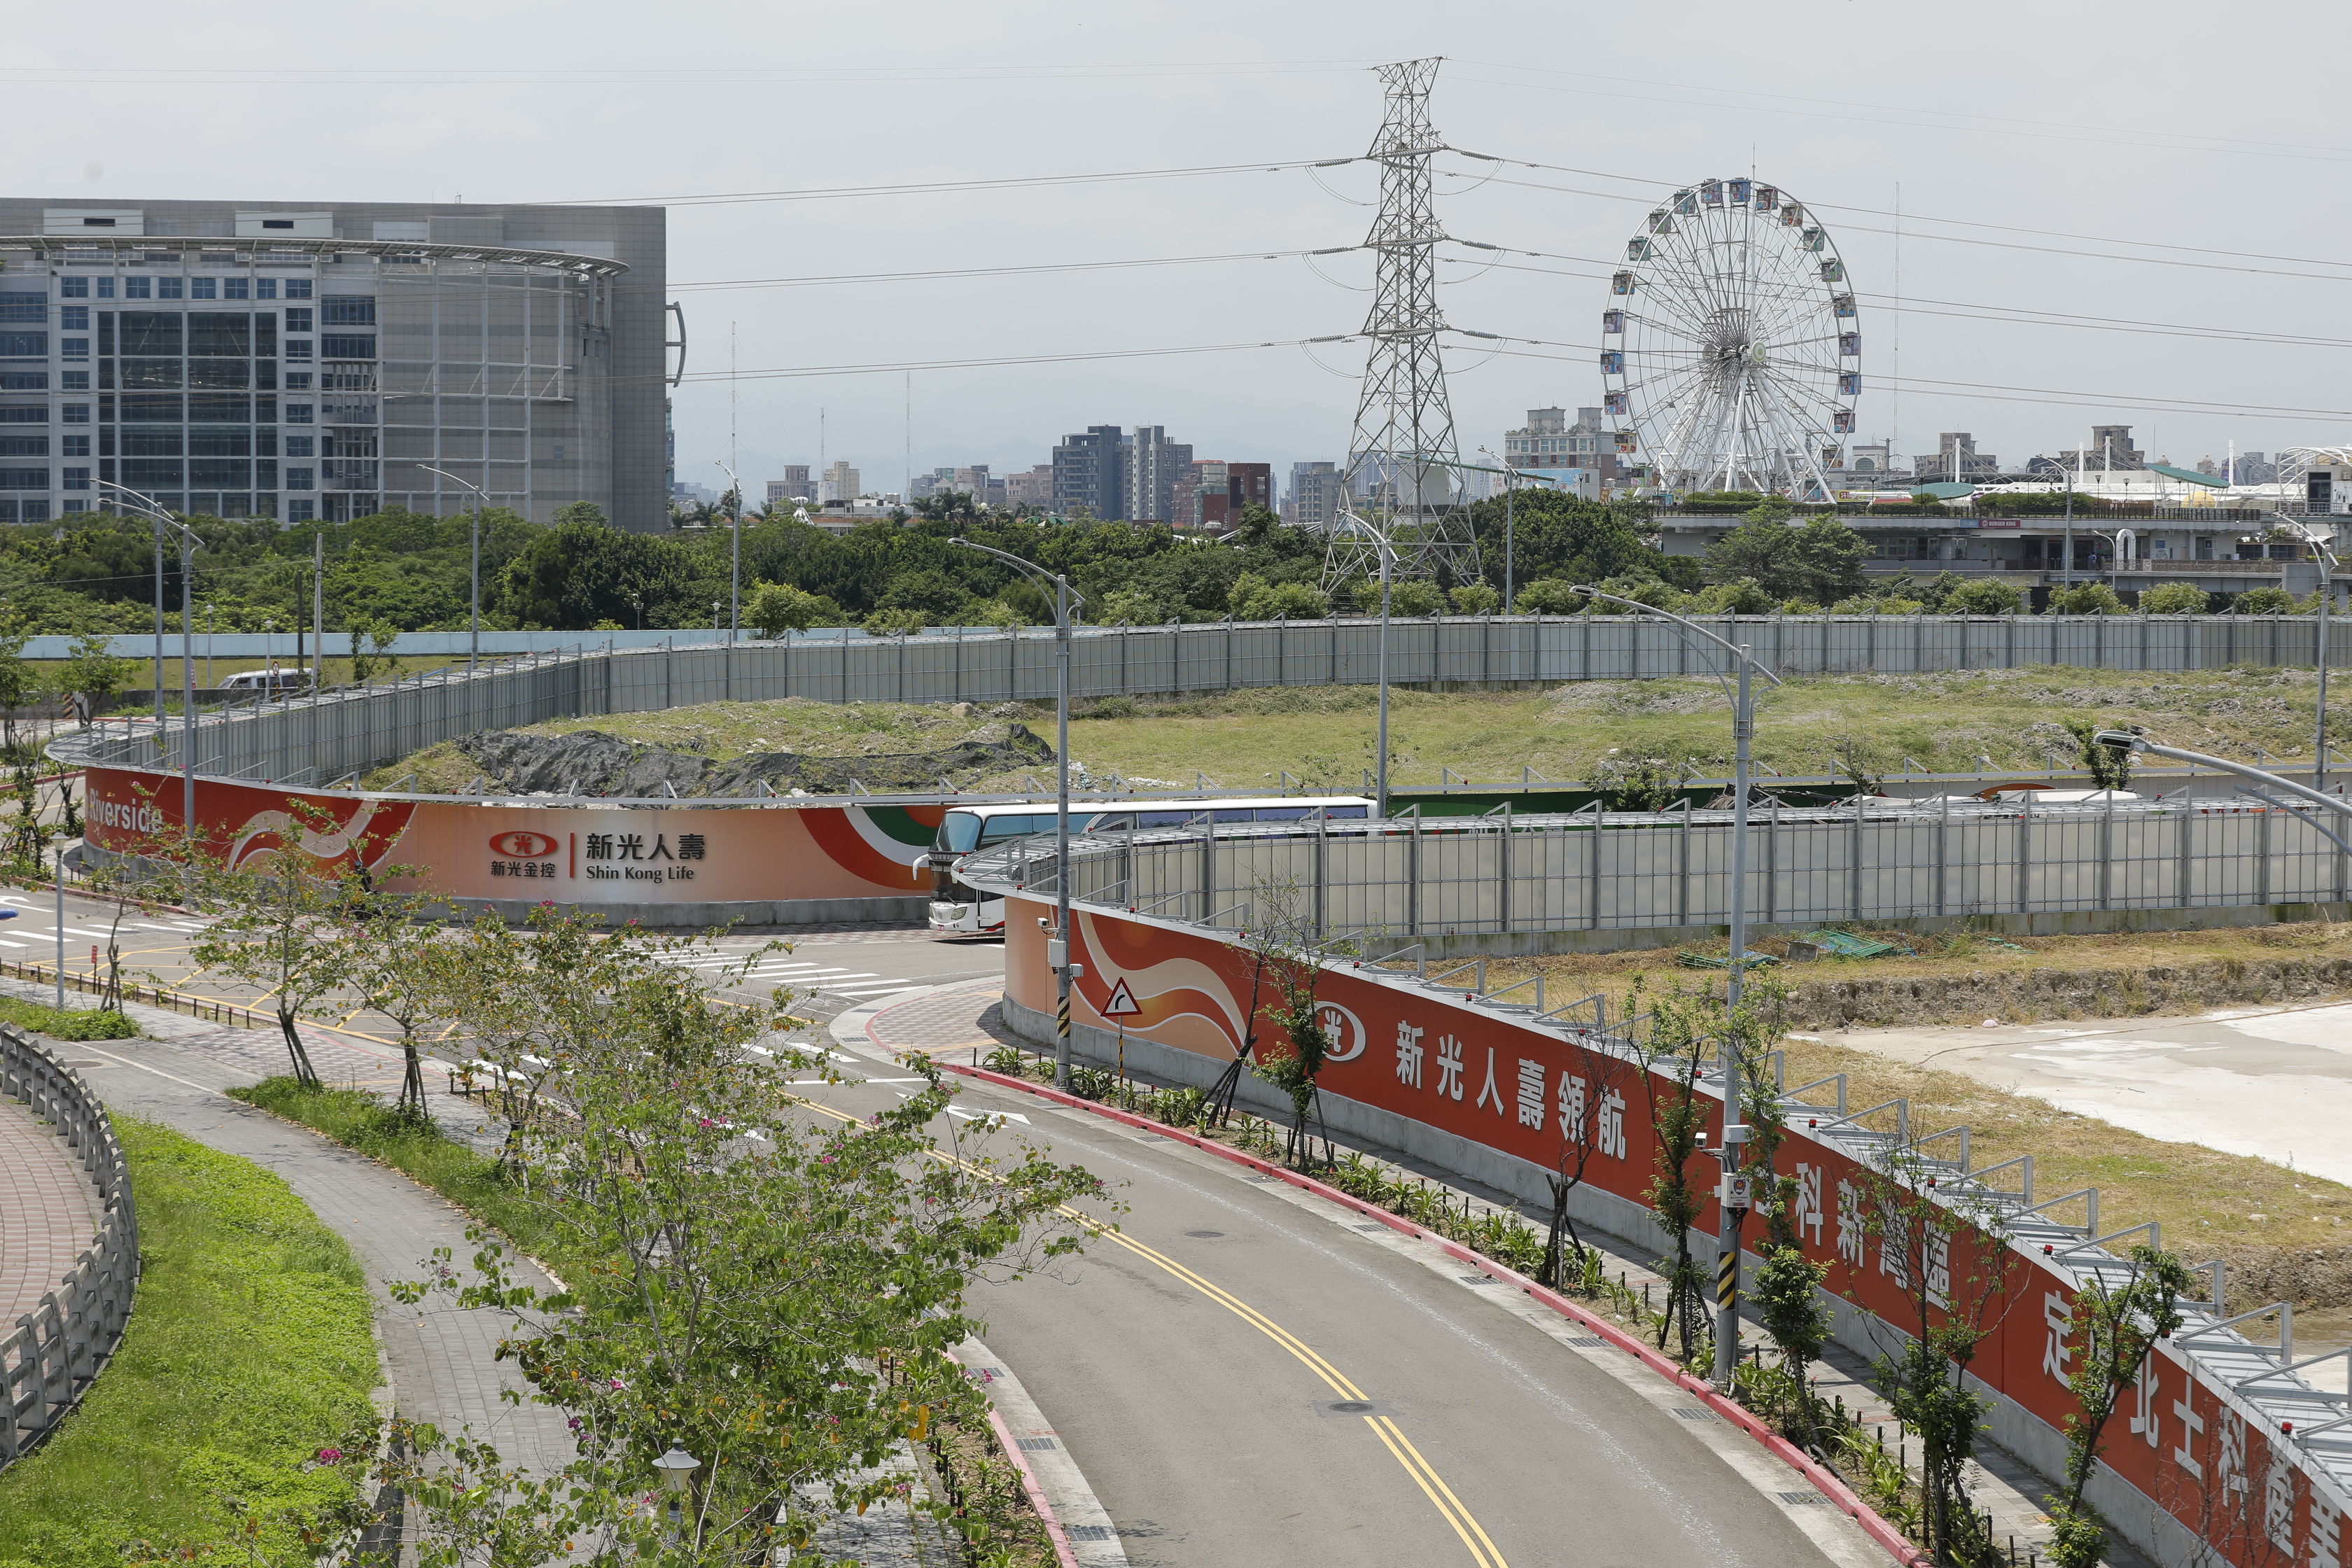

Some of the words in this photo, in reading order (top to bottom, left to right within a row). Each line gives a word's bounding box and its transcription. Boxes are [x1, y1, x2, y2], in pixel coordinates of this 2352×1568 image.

[90, 788, 162, 834] Riverside
[514, 834, 533, 854] 光
[586, 833, 705, 860] 新光人壽
[491, 860, 555, 878] 新光金控
[586, 866, 620, 879] Shin
[625, 866, 662, 883] Kong
[668, 866, 694, 880] Life
[1396, 1020, 1626, 1161] 新光人壽領航
